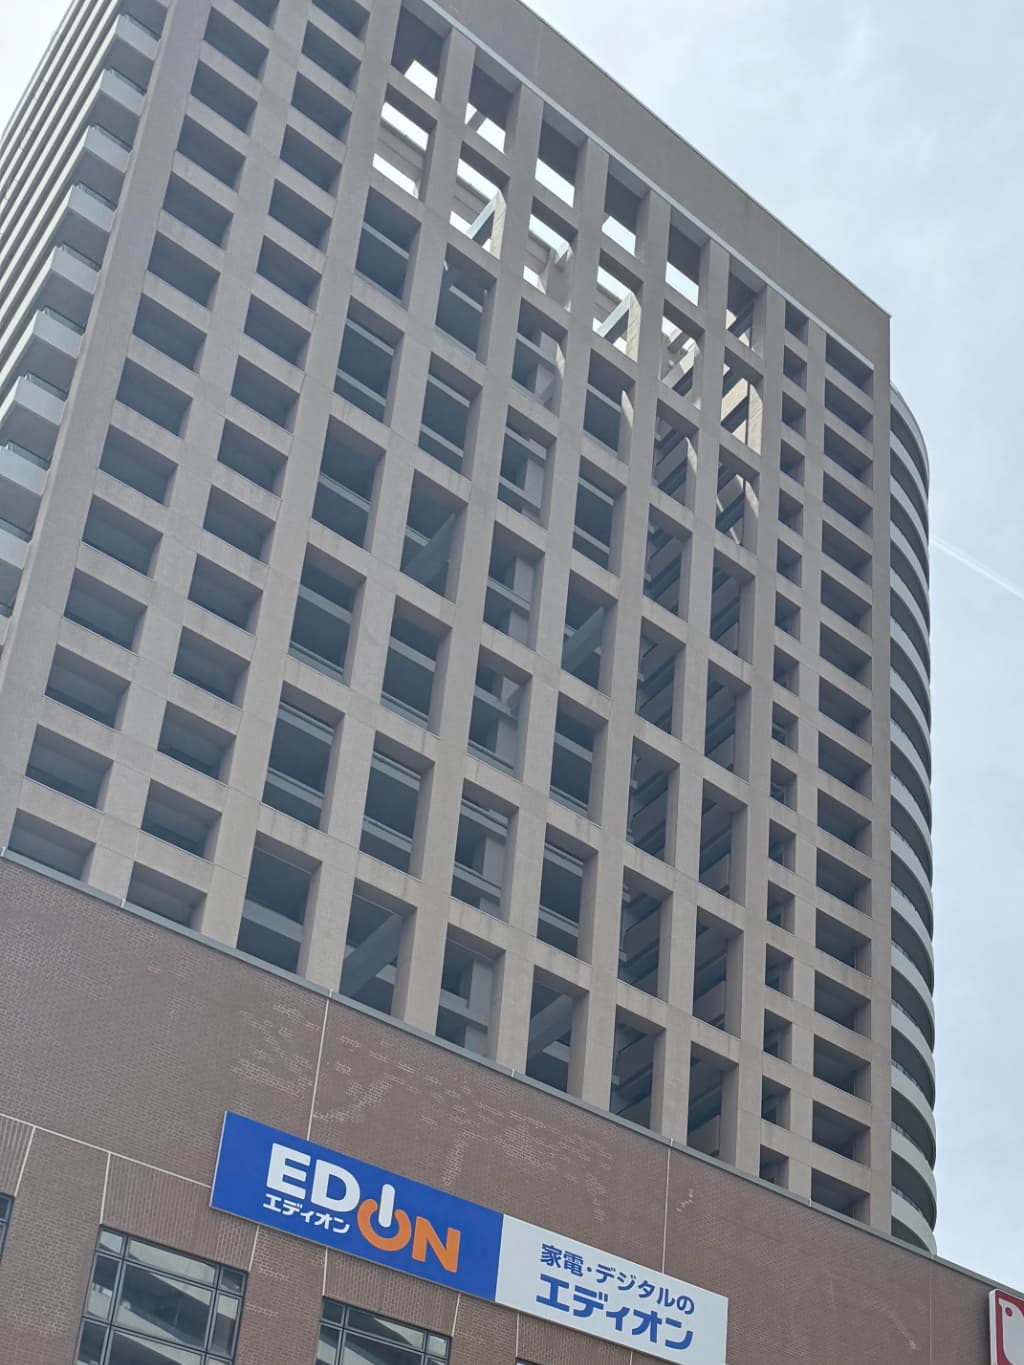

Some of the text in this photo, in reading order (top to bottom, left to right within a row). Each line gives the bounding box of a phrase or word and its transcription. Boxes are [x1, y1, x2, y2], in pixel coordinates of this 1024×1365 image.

[263, 1192, 351, 1234] エディオン
[265, 1142, 461, 1273] EDION
[535, 1273, 694, 1350] エディオン
[539, 1243, 695, 1316] 家電・デジタルの
